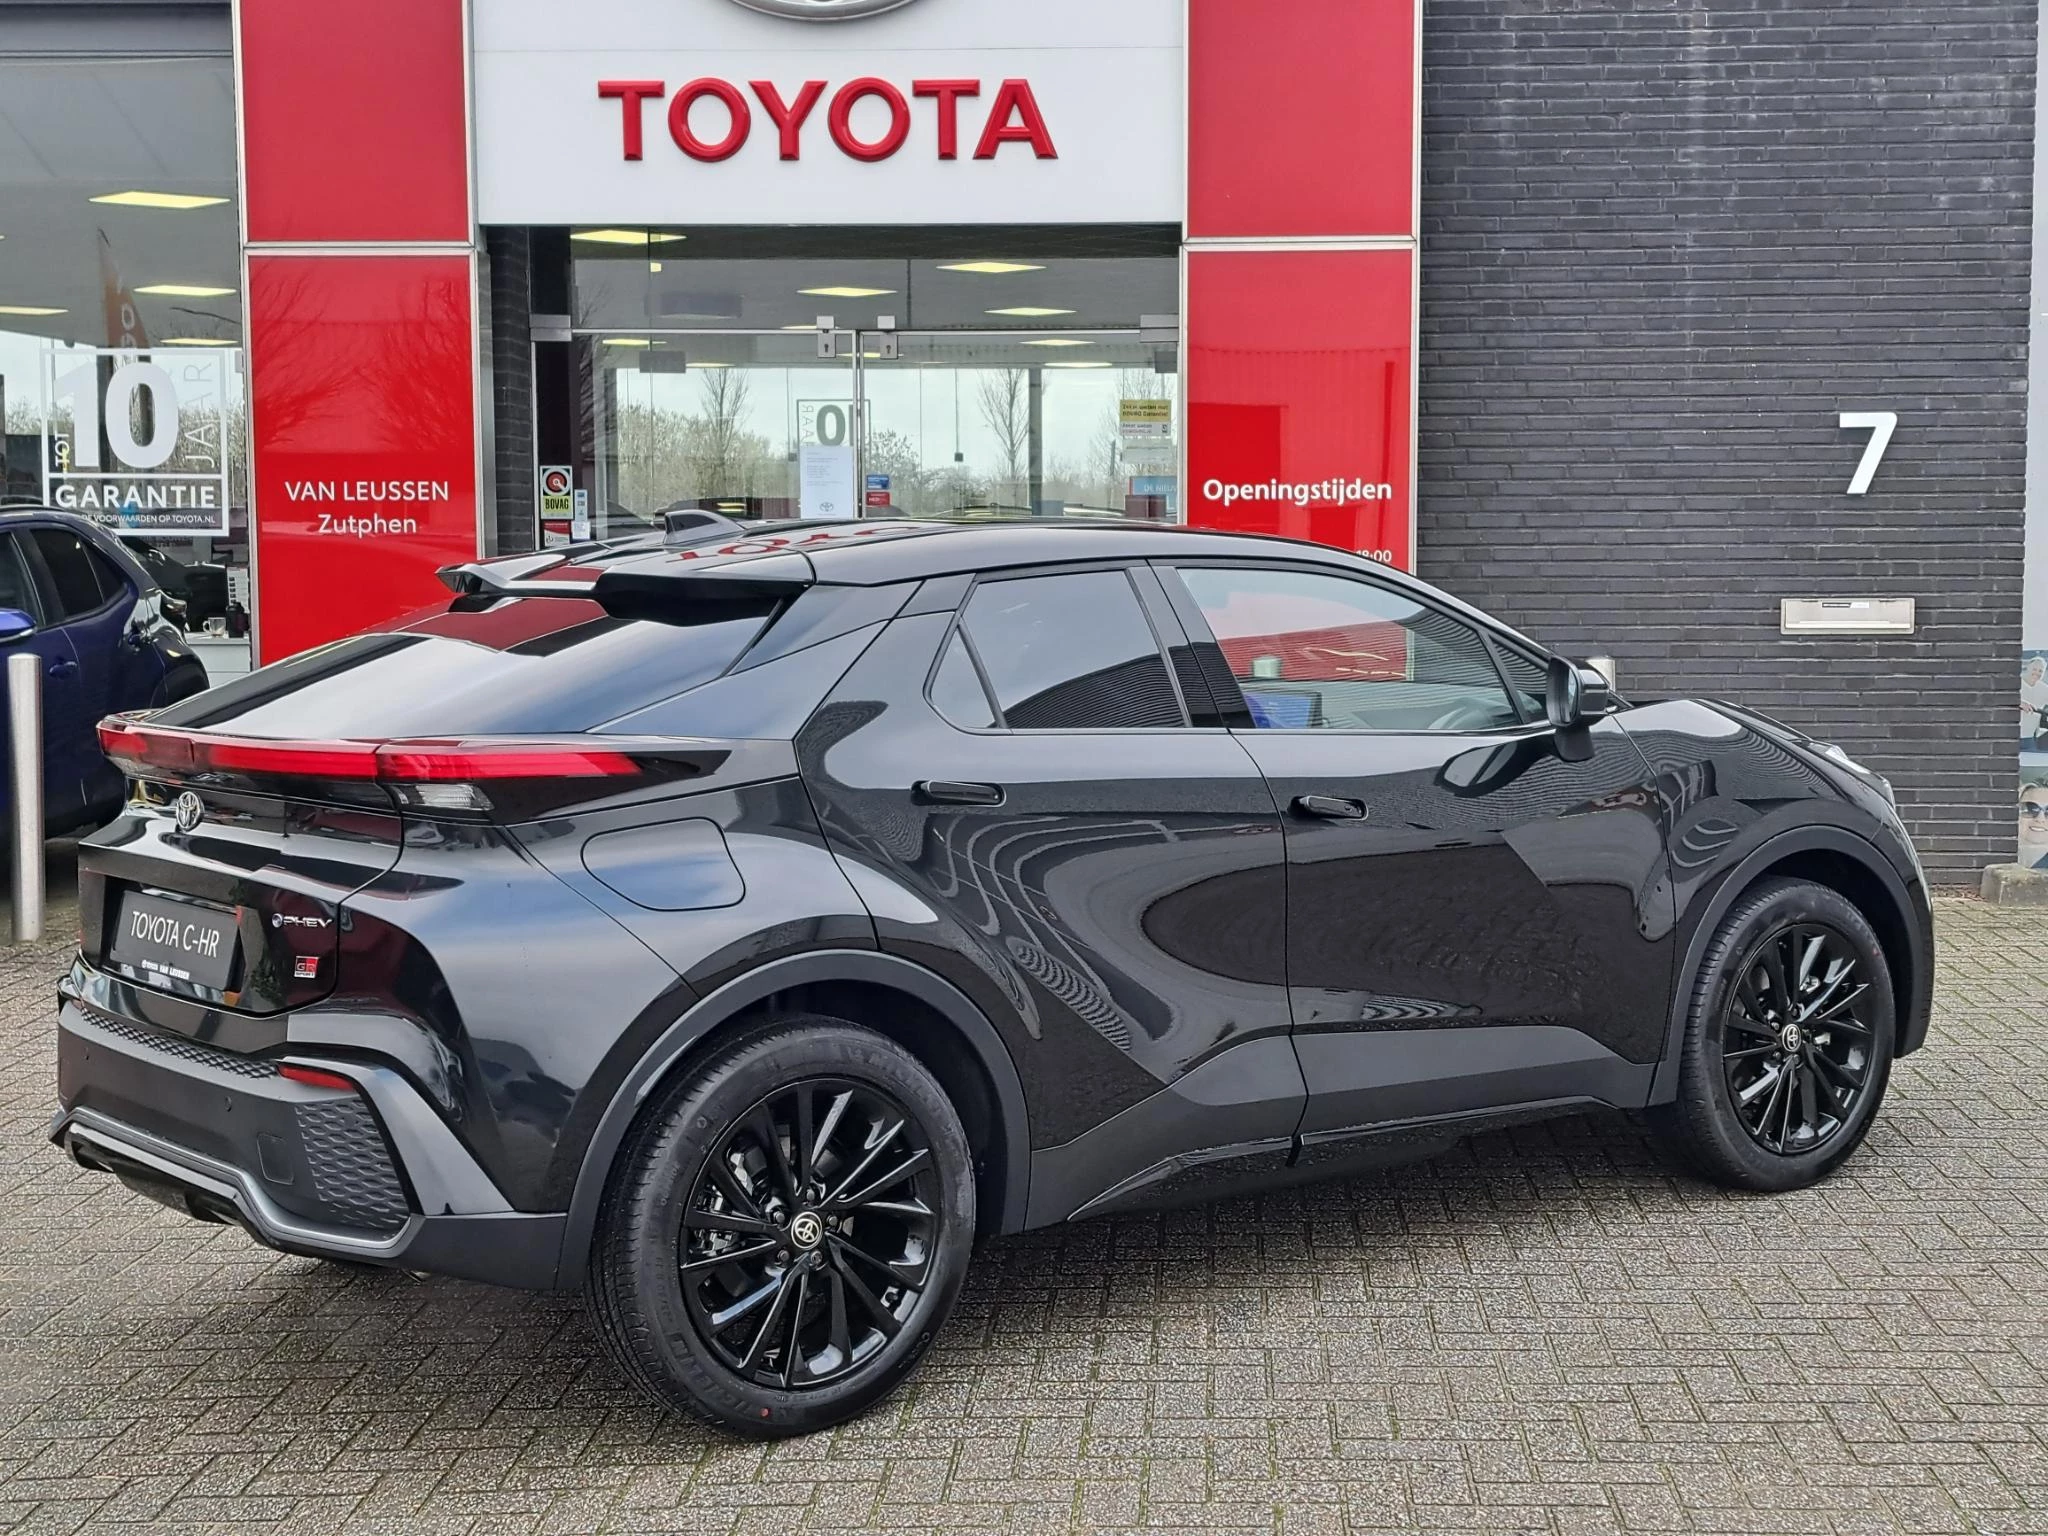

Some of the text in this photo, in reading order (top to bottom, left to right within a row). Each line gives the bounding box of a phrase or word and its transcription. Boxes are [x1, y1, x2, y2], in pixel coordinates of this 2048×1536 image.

[597, 76, 1059, 163] TOYOTA
[54, 361, 180, 470] 10
[54, 432, 71, 468] TOT
[1839, 412, 1897, 495] 7
[55, 484, 216, 508] GARANTIE
[284, 480, 450, 502] VAN LEUSSEN
[545, 497, 570, 510] BOVAG
[1202, 477, 1393, 506] Openingstijden
[94, 514, 158, 524] VOORWAARDEN
[158, 514, 171, 524] OP
[172, 514, 216, 524] TOYOTA.NL
[317, 513, 418, 538] Zutphen
[130, 910, 221, 959] TOYOTA C-HR
[283, 915, 333, 929] PHEV
[296, 963, 317, 973] GR
